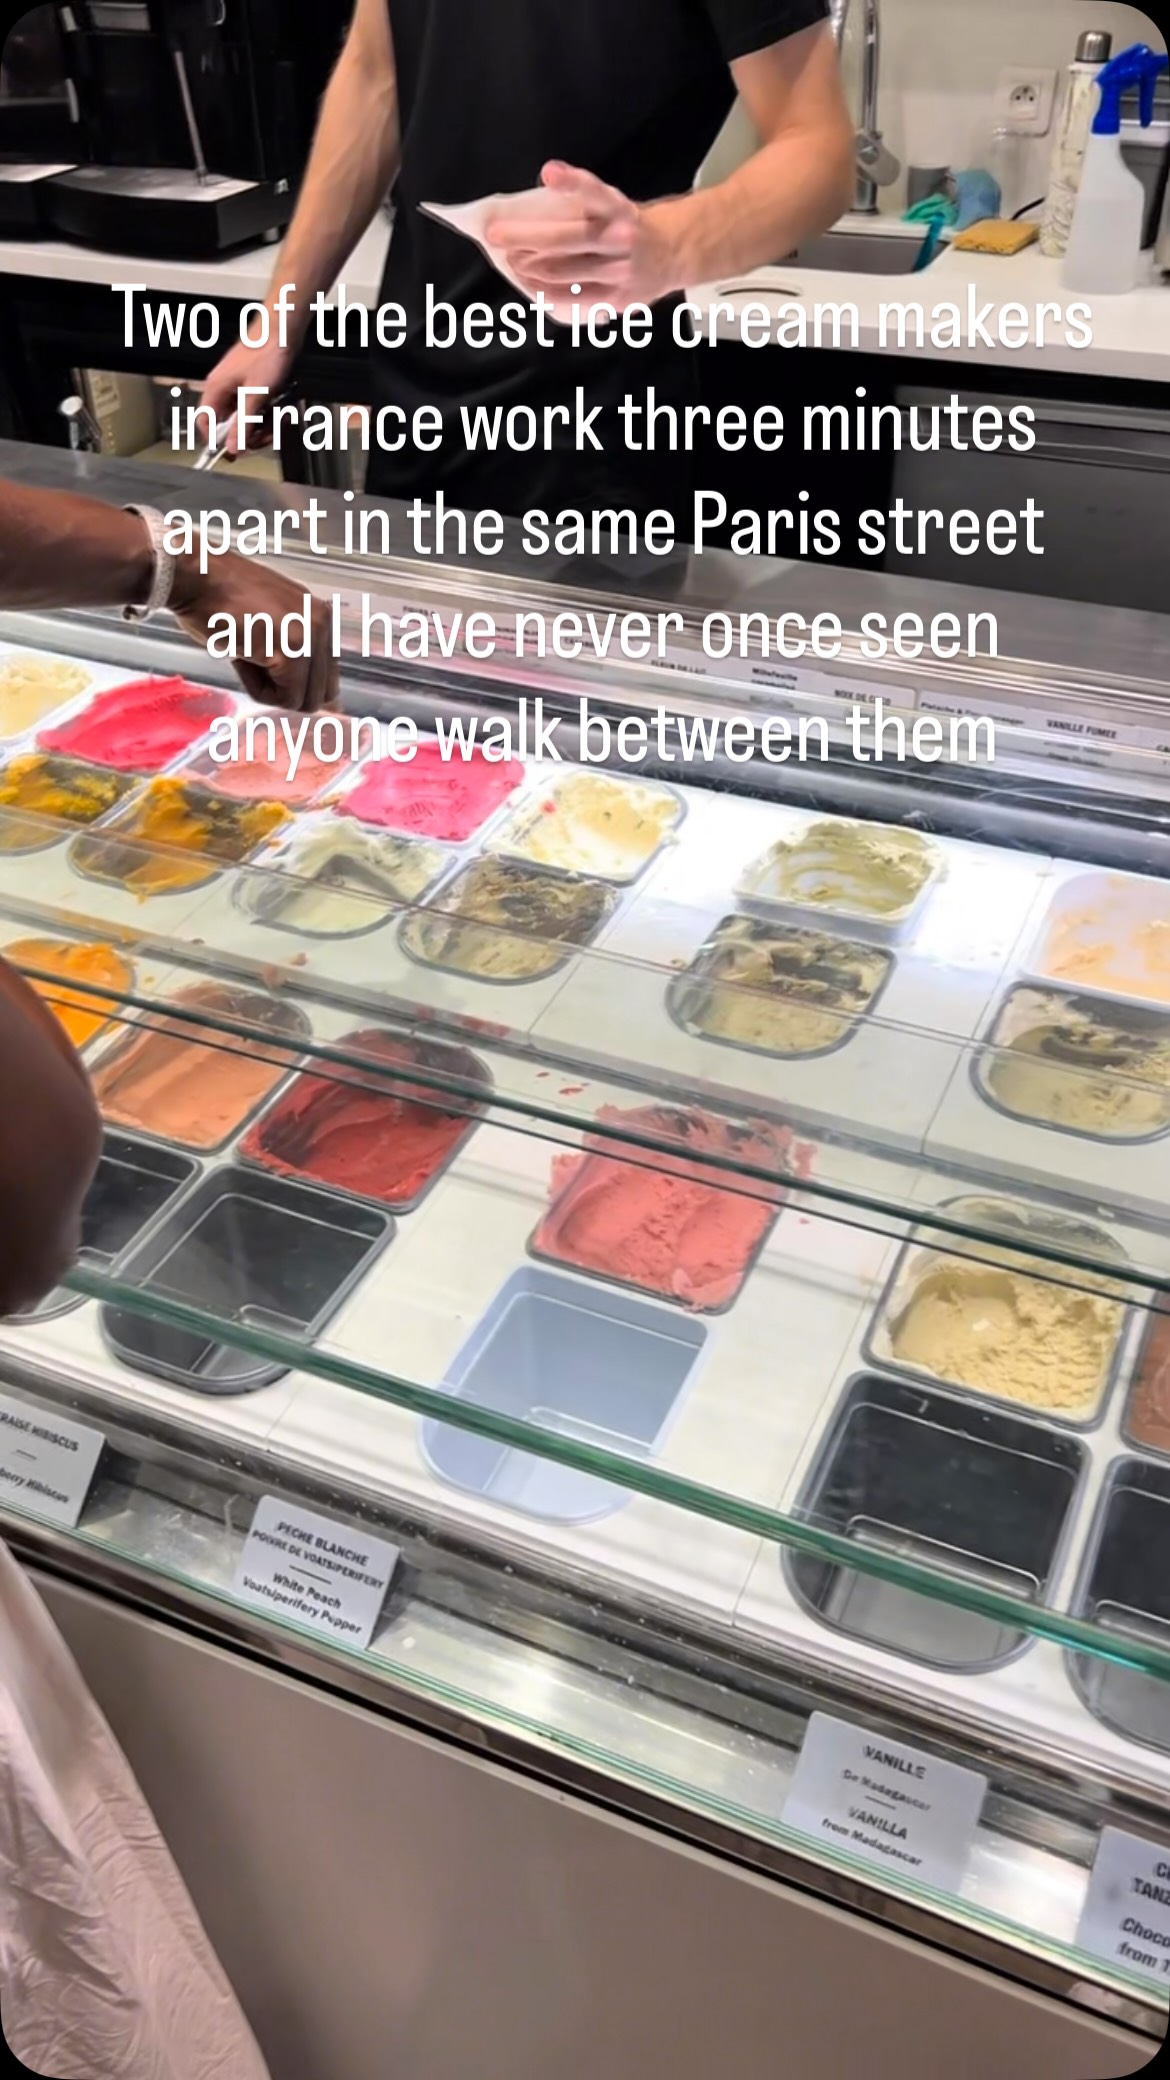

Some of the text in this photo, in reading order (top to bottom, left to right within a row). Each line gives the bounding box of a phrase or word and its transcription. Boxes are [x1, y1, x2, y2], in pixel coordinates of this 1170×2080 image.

[1046, 719, 1084, 733] VANILLE
[0, 1411, 79, 1452] RAISE HIBISCUS
[288, 1545, 302, 1557] DE
[314, 1537, 370, 1567] BLANCHE
[273, 1572, 342, 1610] White Peach
[864, 1744, 926, 1780] VANILLE
[861, 1776, 931, 1811] Madagascar
[848, 1806, 908, 1840] VANILLA
[821, 1818, 922, 1866] from Madagascar
[1118, 1941, 1158, 1969] from
